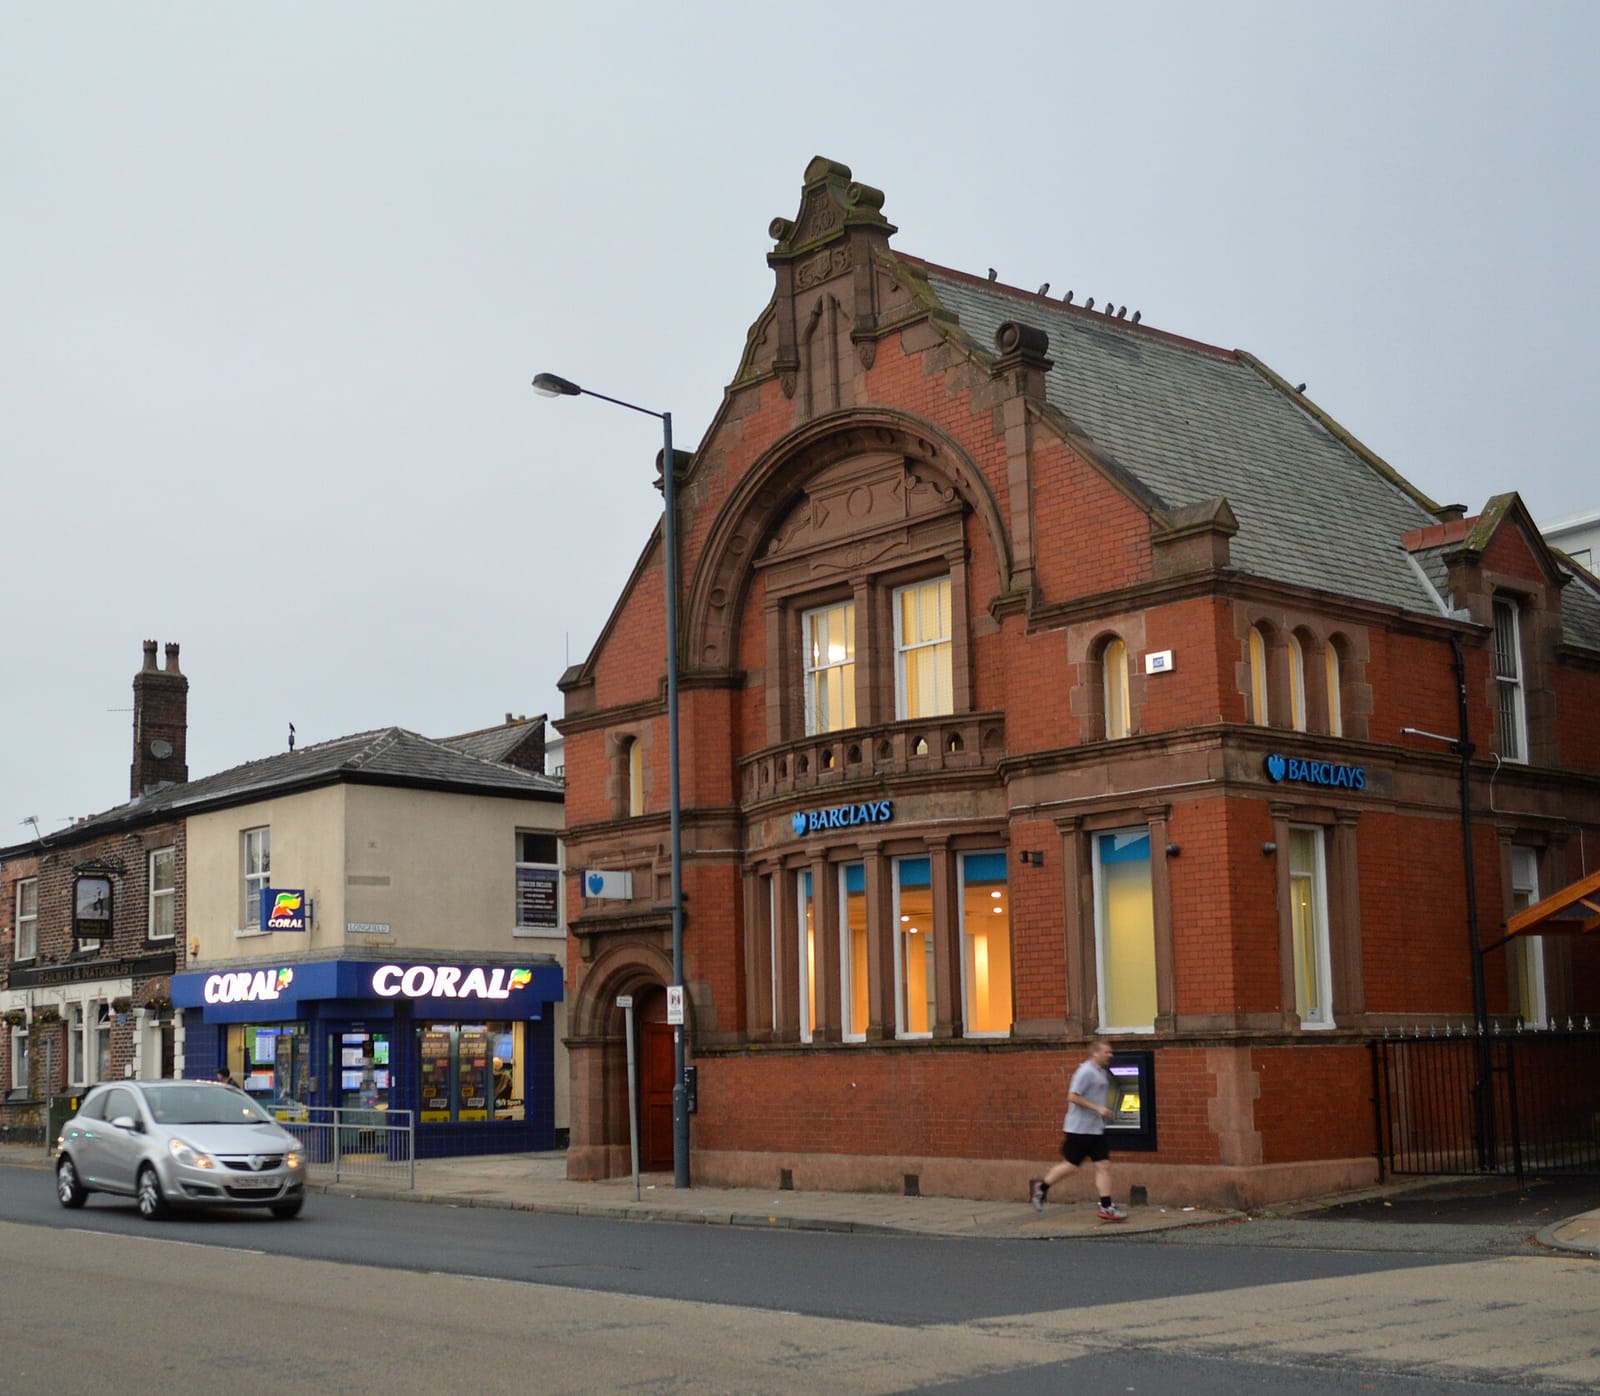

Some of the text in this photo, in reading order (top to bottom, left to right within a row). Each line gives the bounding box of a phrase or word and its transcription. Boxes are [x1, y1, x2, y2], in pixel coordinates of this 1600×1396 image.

[1288, 758, 1366, 789] BARCLAYS
[808, 800, 893, 831] BARCLAYS
[267, 918, 303, 929] CORAL
[38, 964, 134, 984] RAILWAY & NATURALIST
[204, 969, 280, 1004] CORAL
[372, 965, 510, 999] CORAL
